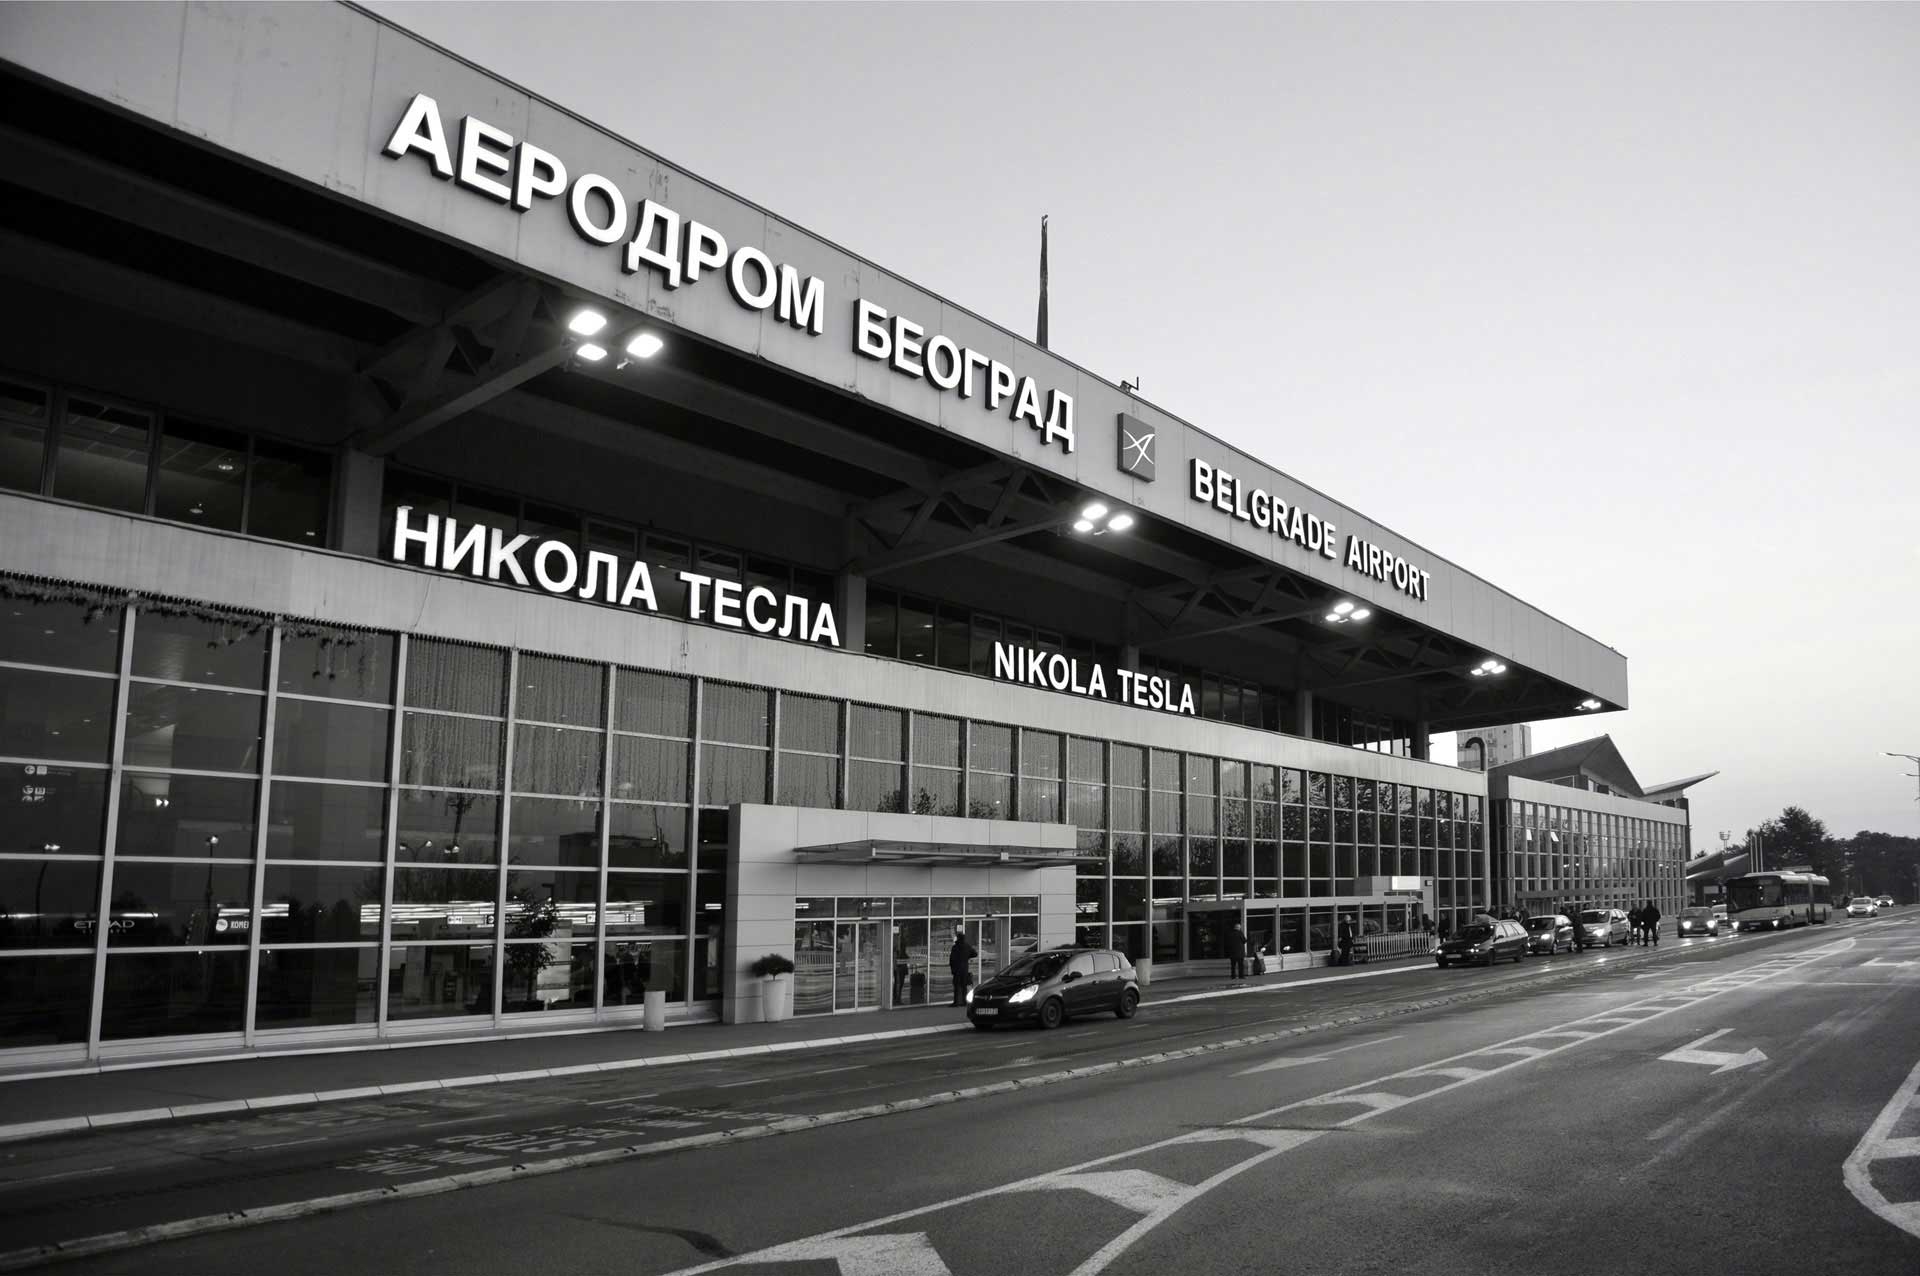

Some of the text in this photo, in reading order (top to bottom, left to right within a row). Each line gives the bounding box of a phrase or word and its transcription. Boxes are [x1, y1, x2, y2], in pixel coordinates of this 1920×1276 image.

[382, 93, 1075, 454] АЕРОДРОМ БЕОГРАД
[393, 505, 840, 647] НИКОЛА ТЕСЛА
[1191, 457, 1431, 602] BELGRADE AIRPORT
[994, 640, 1196, 715] NIKOLA TESLA
[73, 919, 136, 929] ETAD
